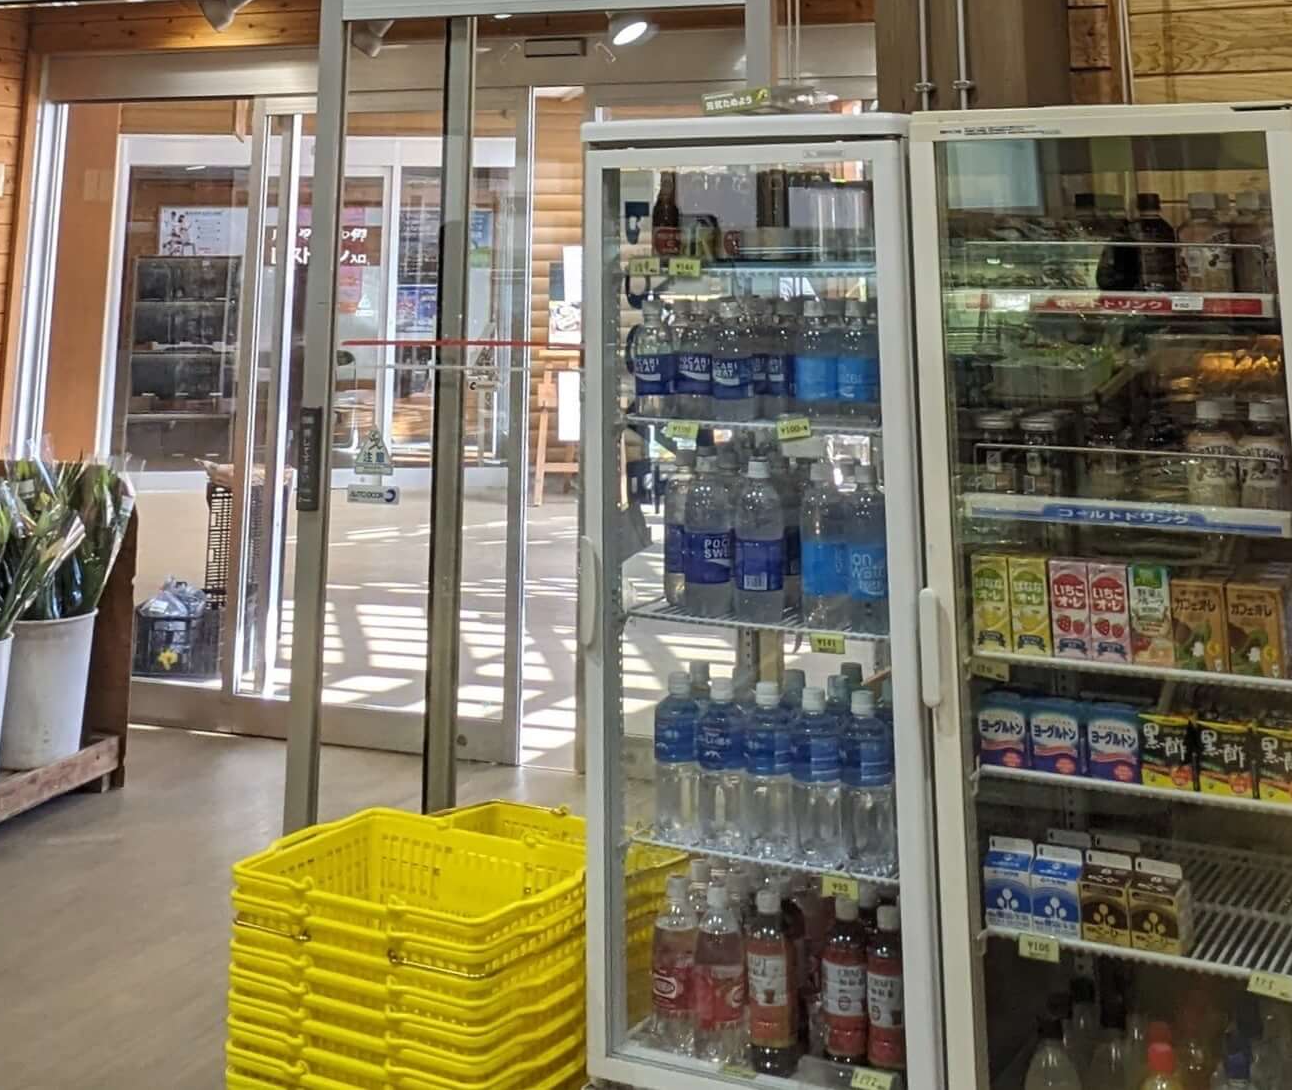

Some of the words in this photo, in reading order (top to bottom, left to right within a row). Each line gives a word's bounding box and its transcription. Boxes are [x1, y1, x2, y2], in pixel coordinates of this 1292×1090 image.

[1058, 508, 1189, 525] コールドドリンク
[1053, 584, 1086, 596] いちご
[1092, 587, 1126, 599] いちご
[981, 718, 1026, 736] ヨーグルトン
[1033, 724, 1078, 742] ヨーグルトン
[1091, 729, 1138, 749] ヨーグルトン
